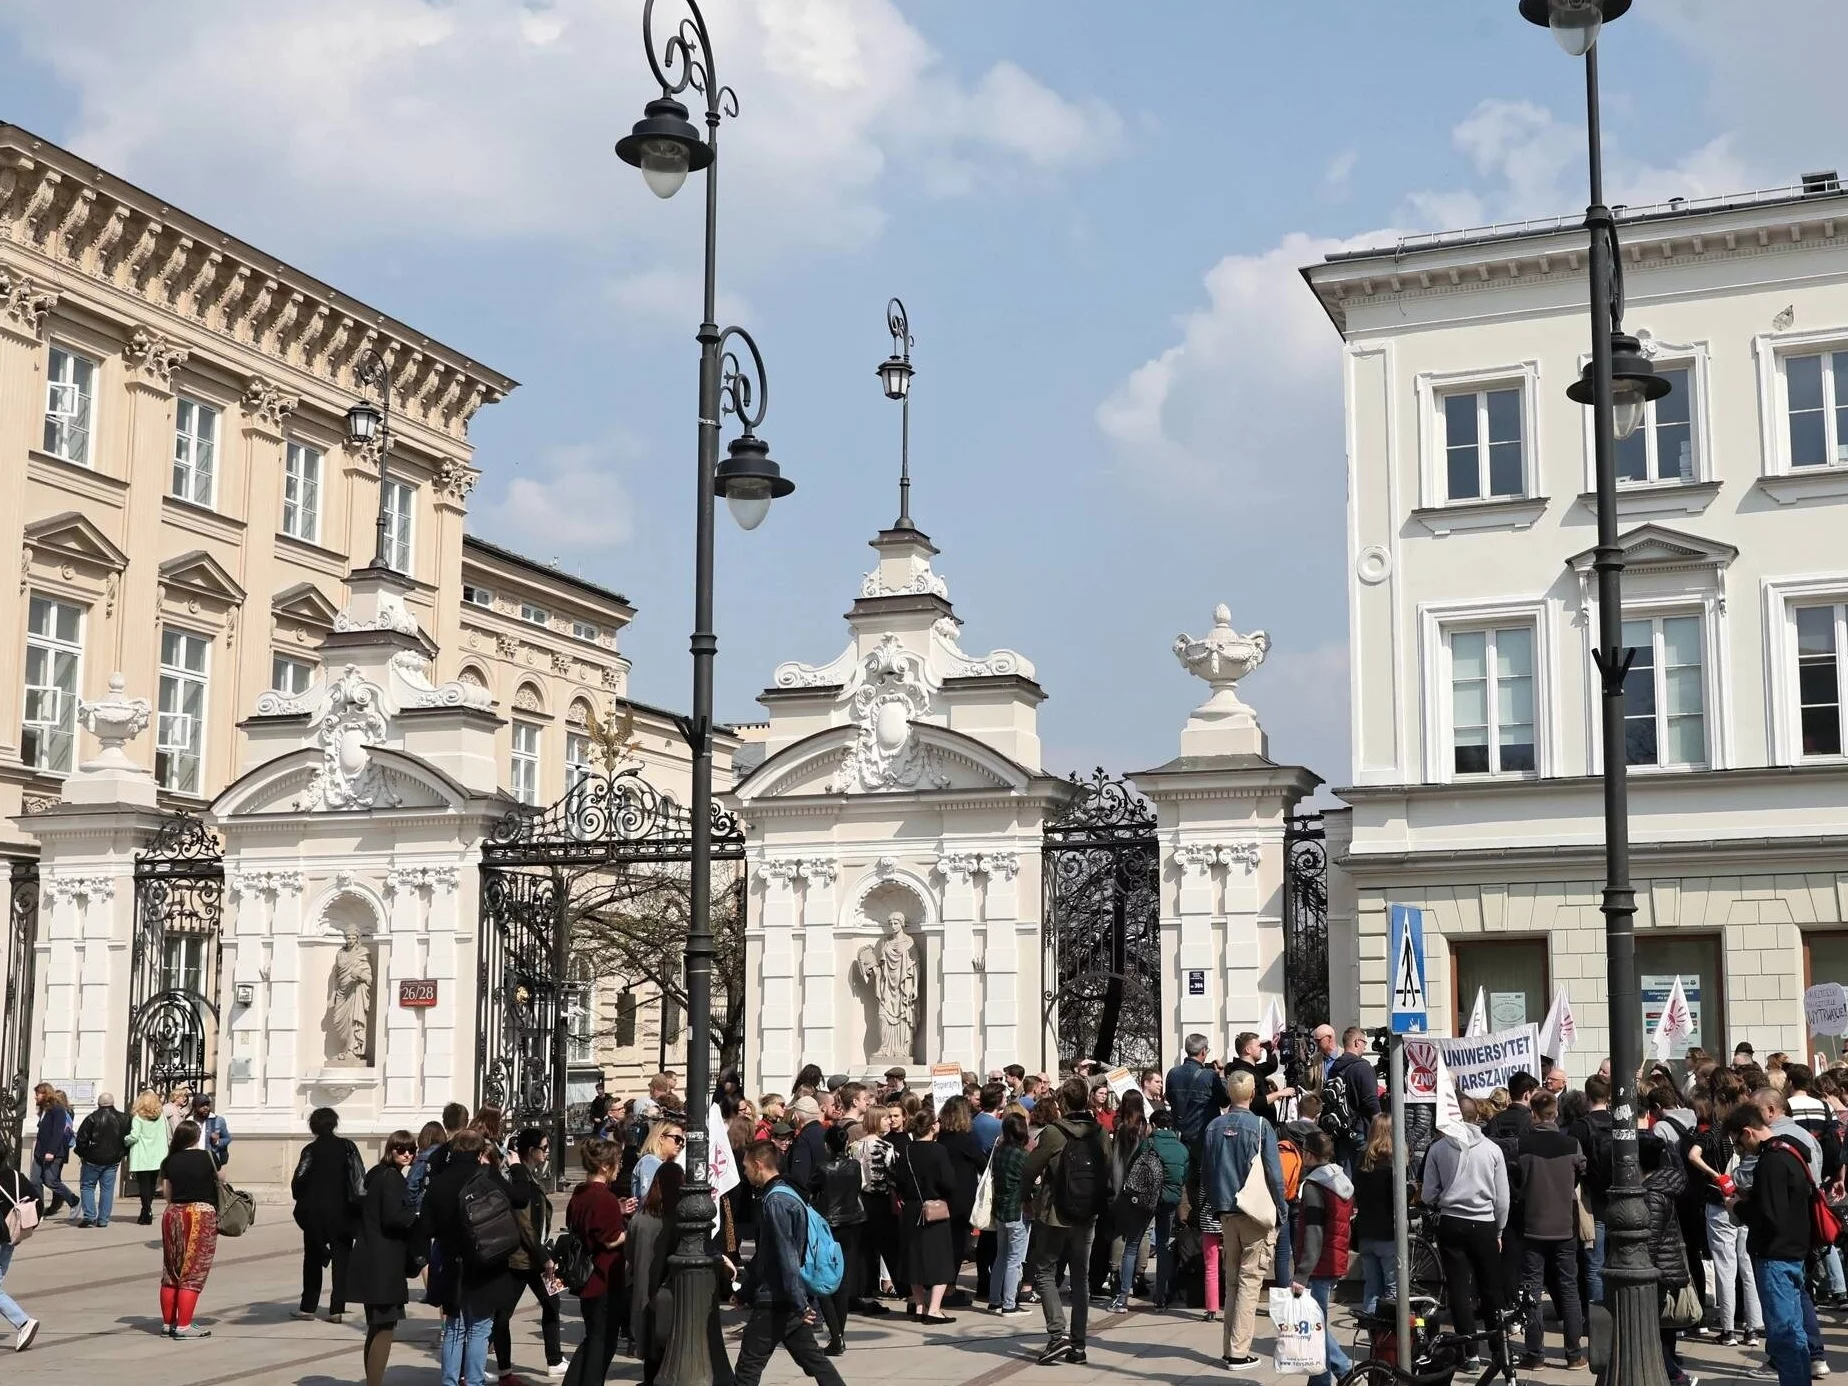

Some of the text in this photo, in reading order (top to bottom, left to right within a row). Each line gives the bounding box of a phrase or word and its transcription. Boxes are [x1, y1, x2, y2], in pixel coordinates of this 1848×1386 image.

[402, 985, 434, 1000] 26/28
[1443, 1036, 1530, 1067] UNIWERSYTET
[1412, 1072, 1435, 1087] ZNP
